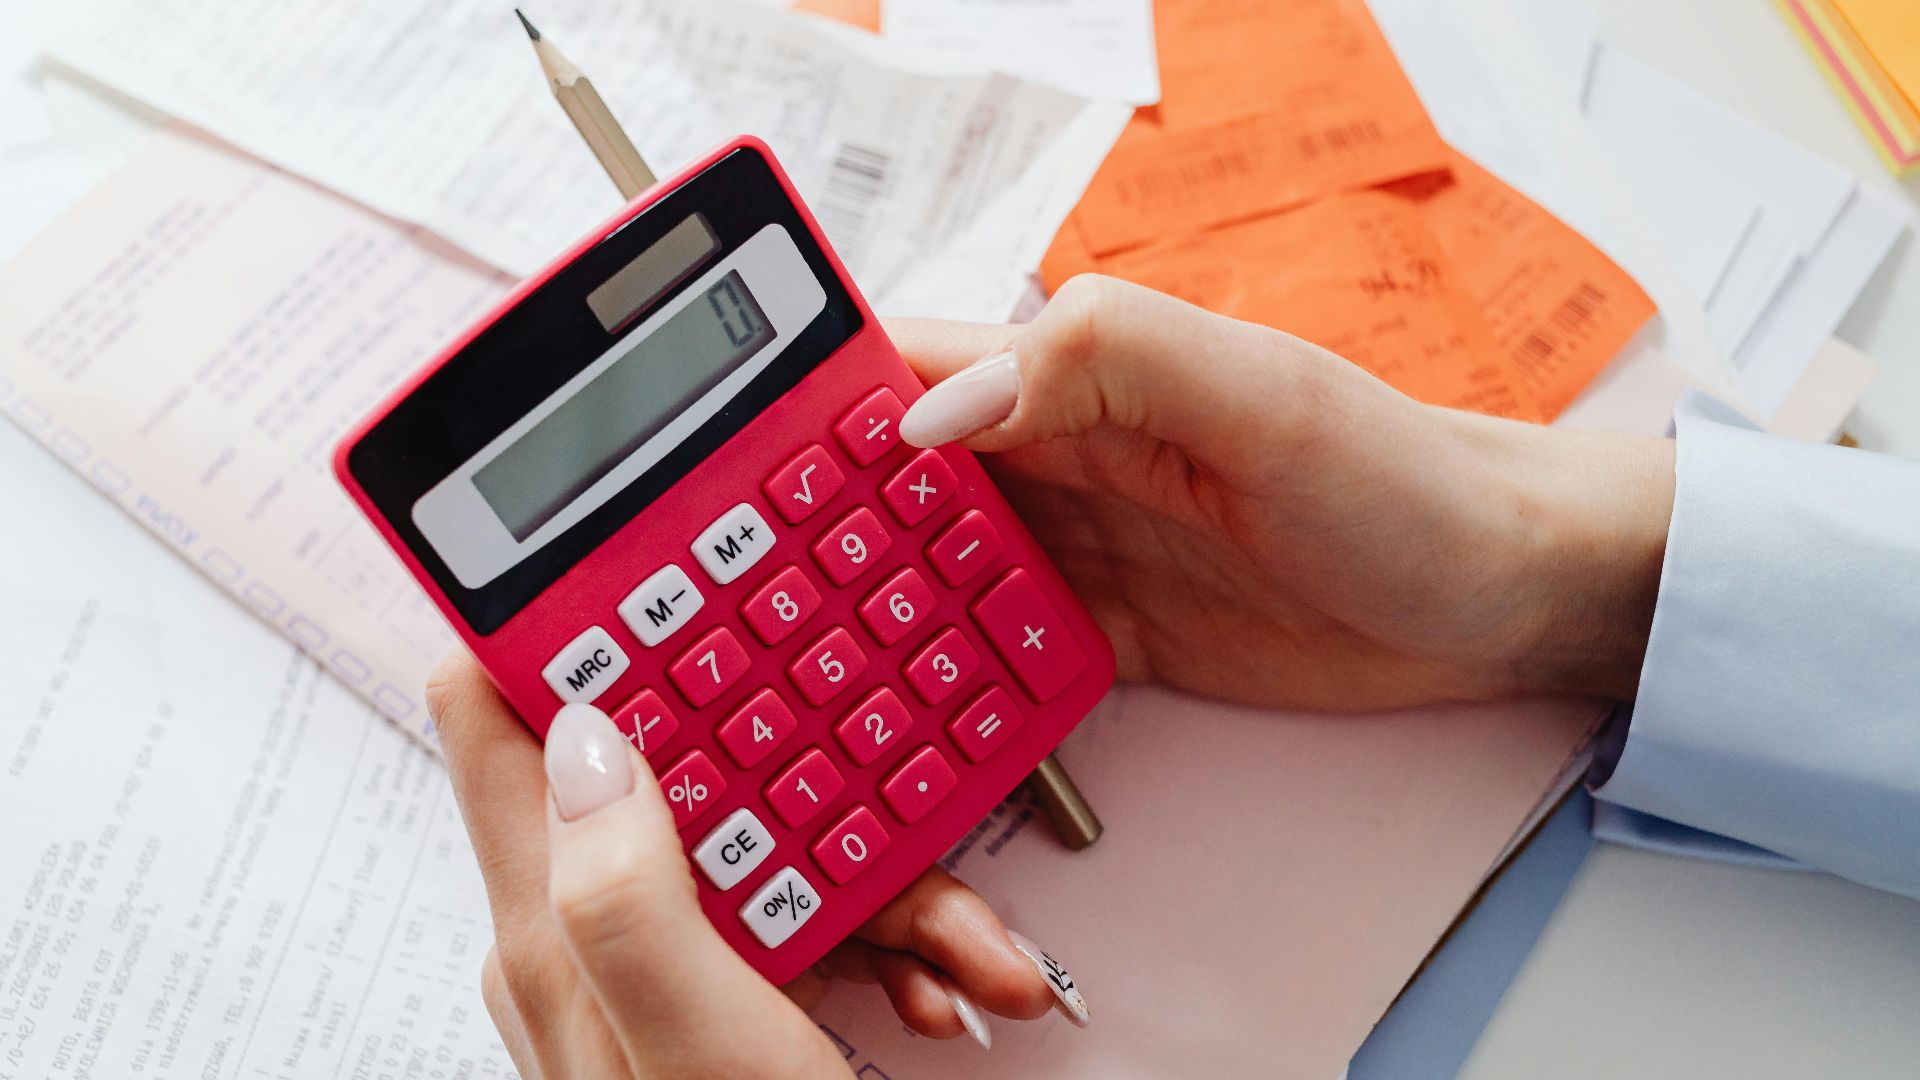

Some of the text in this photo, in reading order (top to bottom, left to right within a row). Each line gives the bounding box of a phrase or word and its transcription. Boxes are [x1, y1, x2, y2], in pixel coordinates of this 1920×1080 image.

[714, 524, 757, 567] M+
[840, 531, 868, 564] 9
[771, 590, 799, 622] 8
[888, 594, 916, 623] 6
[566, 648, 612, 692] MRC
[696, 650, 721, 684] 7
[817, 650, 846, 683] 5
[931, 654, 958, 683] 3
[751, 712, 774, 744] 4
[864, 711, 894, 745] 2
[668, 774, 708, 812] %
[797, 776, 819, 803] 1
[720, 828, 758, 865] CE
[841, 833, 868, 862] 0
[763, 880, 811, 921] ON/C
